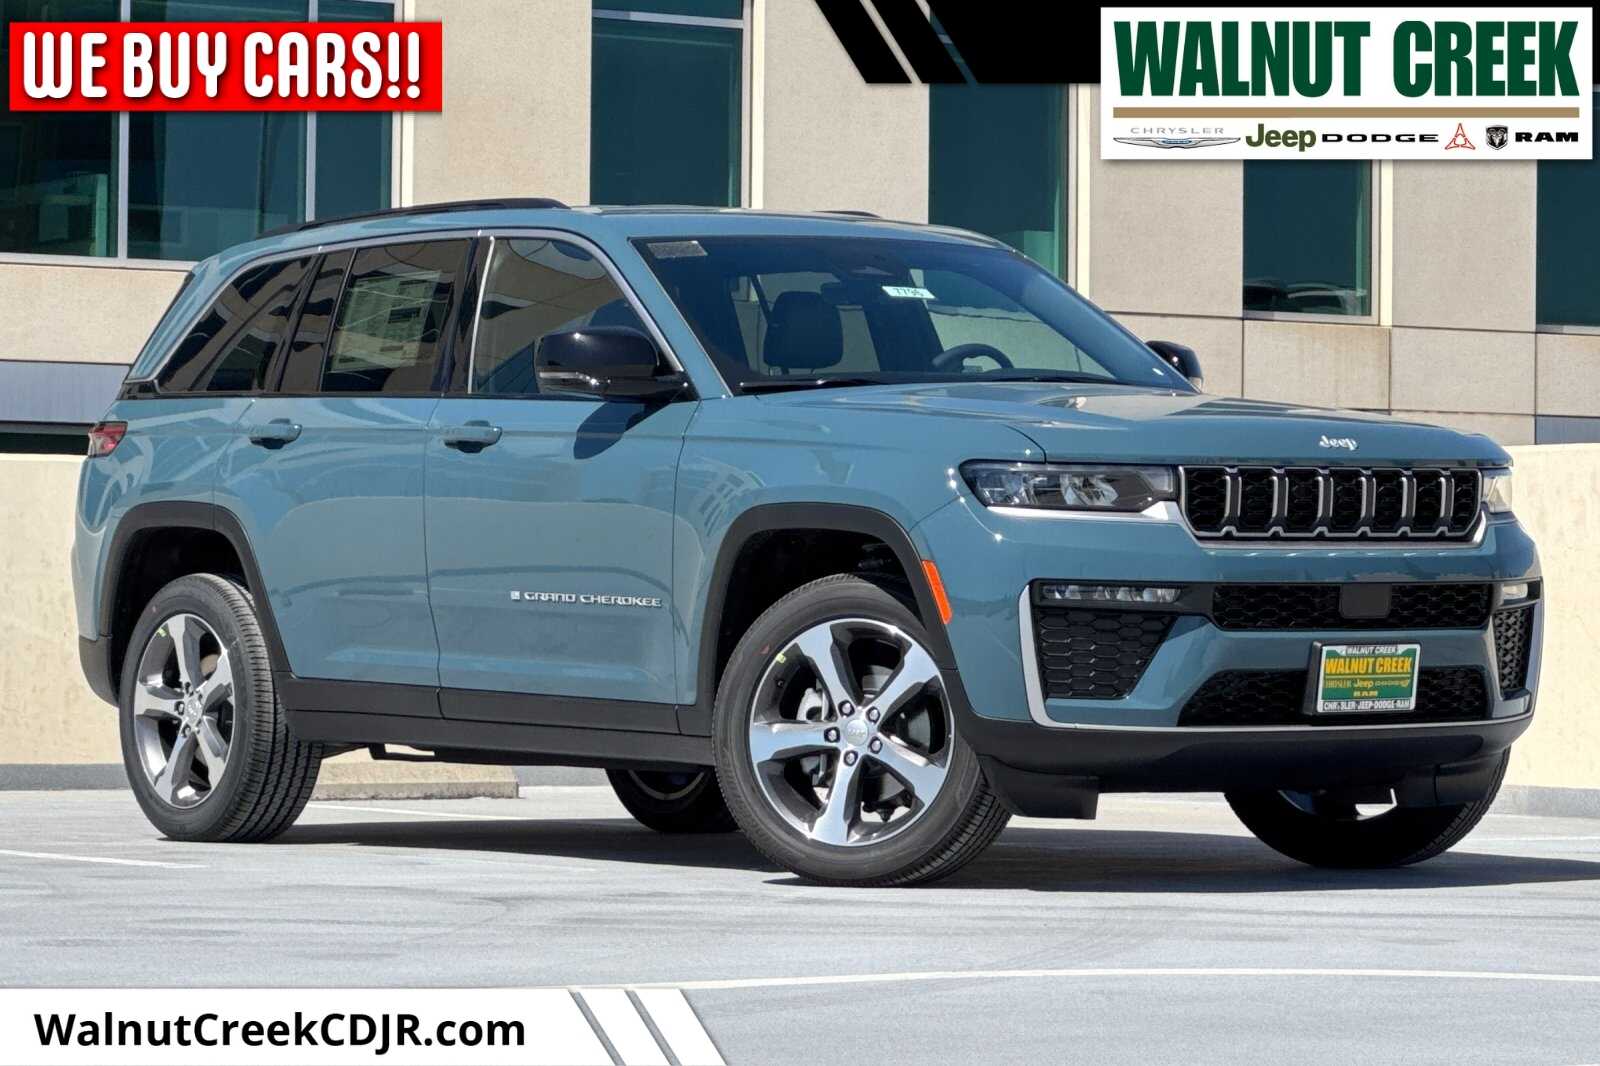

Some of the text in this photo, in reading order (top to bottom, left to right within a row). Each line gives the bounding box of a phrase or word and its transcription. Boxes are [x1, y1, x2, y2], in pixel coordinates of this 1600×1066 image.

[1319, 435, 1358, 451] Jeep
[523, 591, 663, 608] GRAND CHEROKEE
[1347, 645, 1398, 655] WALNUT CREEK
[1325, 656, 1413, 674] WALNUT CREEK
